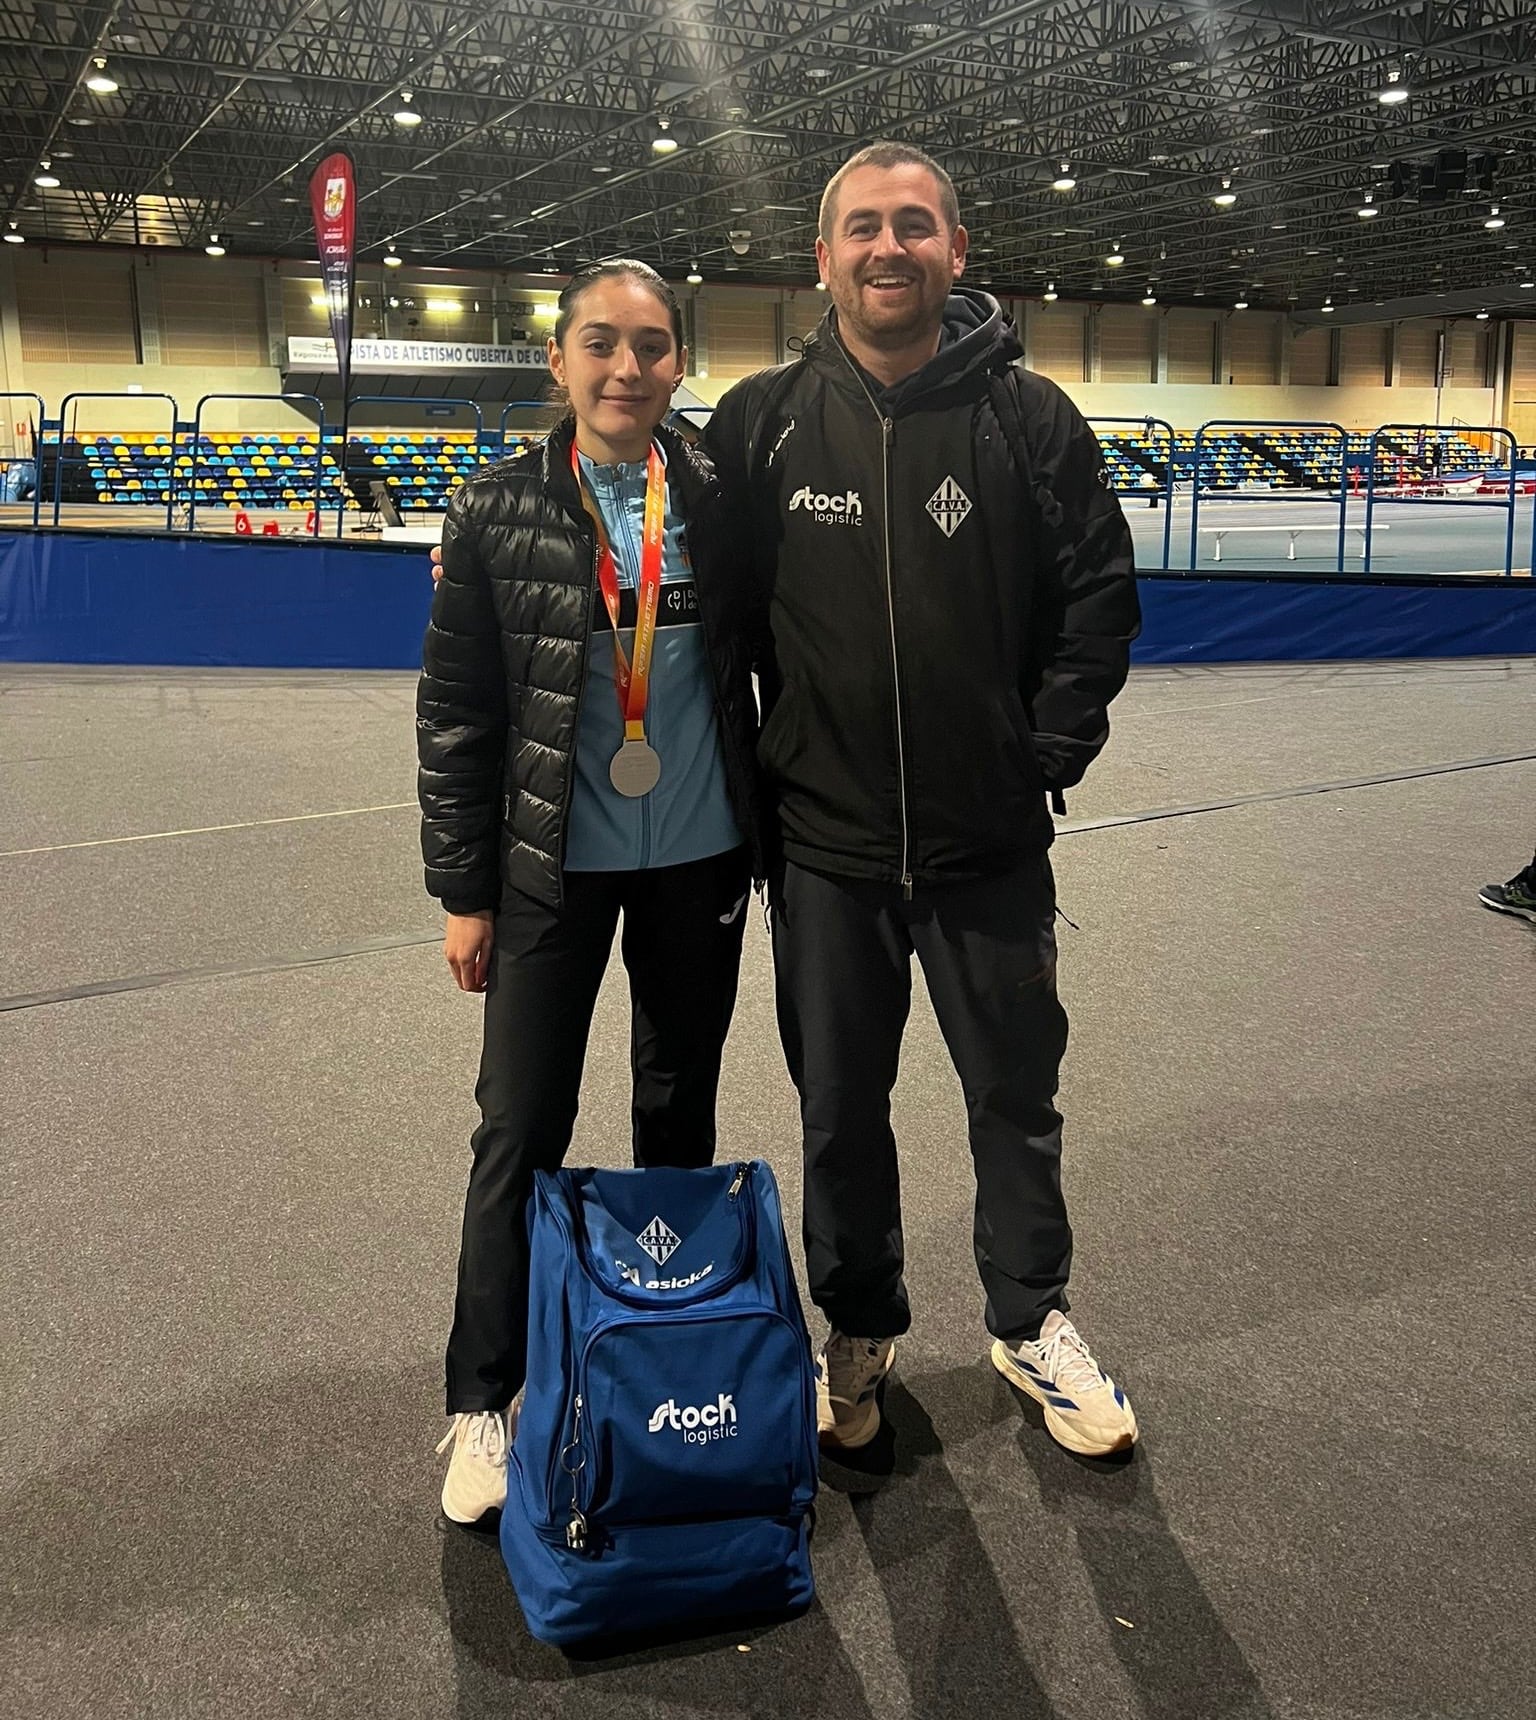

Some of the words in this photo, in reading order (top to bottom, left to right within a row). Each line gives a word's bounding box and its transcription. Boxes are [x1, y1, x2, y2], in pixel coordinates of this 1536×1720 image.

[384, 345, 398, 360] DE
[402, 345, 462, 361] ATLETISMO
[465, 348, 514, 363] CUBERTA
[517, 350, 531, 363] DE
[789, 486, 862, 515] stock
[237, 518, 246, 531] 6
[814, 511, 862, 526] logistic
[643, 580, 655, 642] ATLETISMO
[643, 1236, 674, 1246] C.A.V.A.
[645, 1264, 713, 1289] asioka
[648, 1393, 736, 1432] stock
[683, 1424, 738, 1446] logistic
